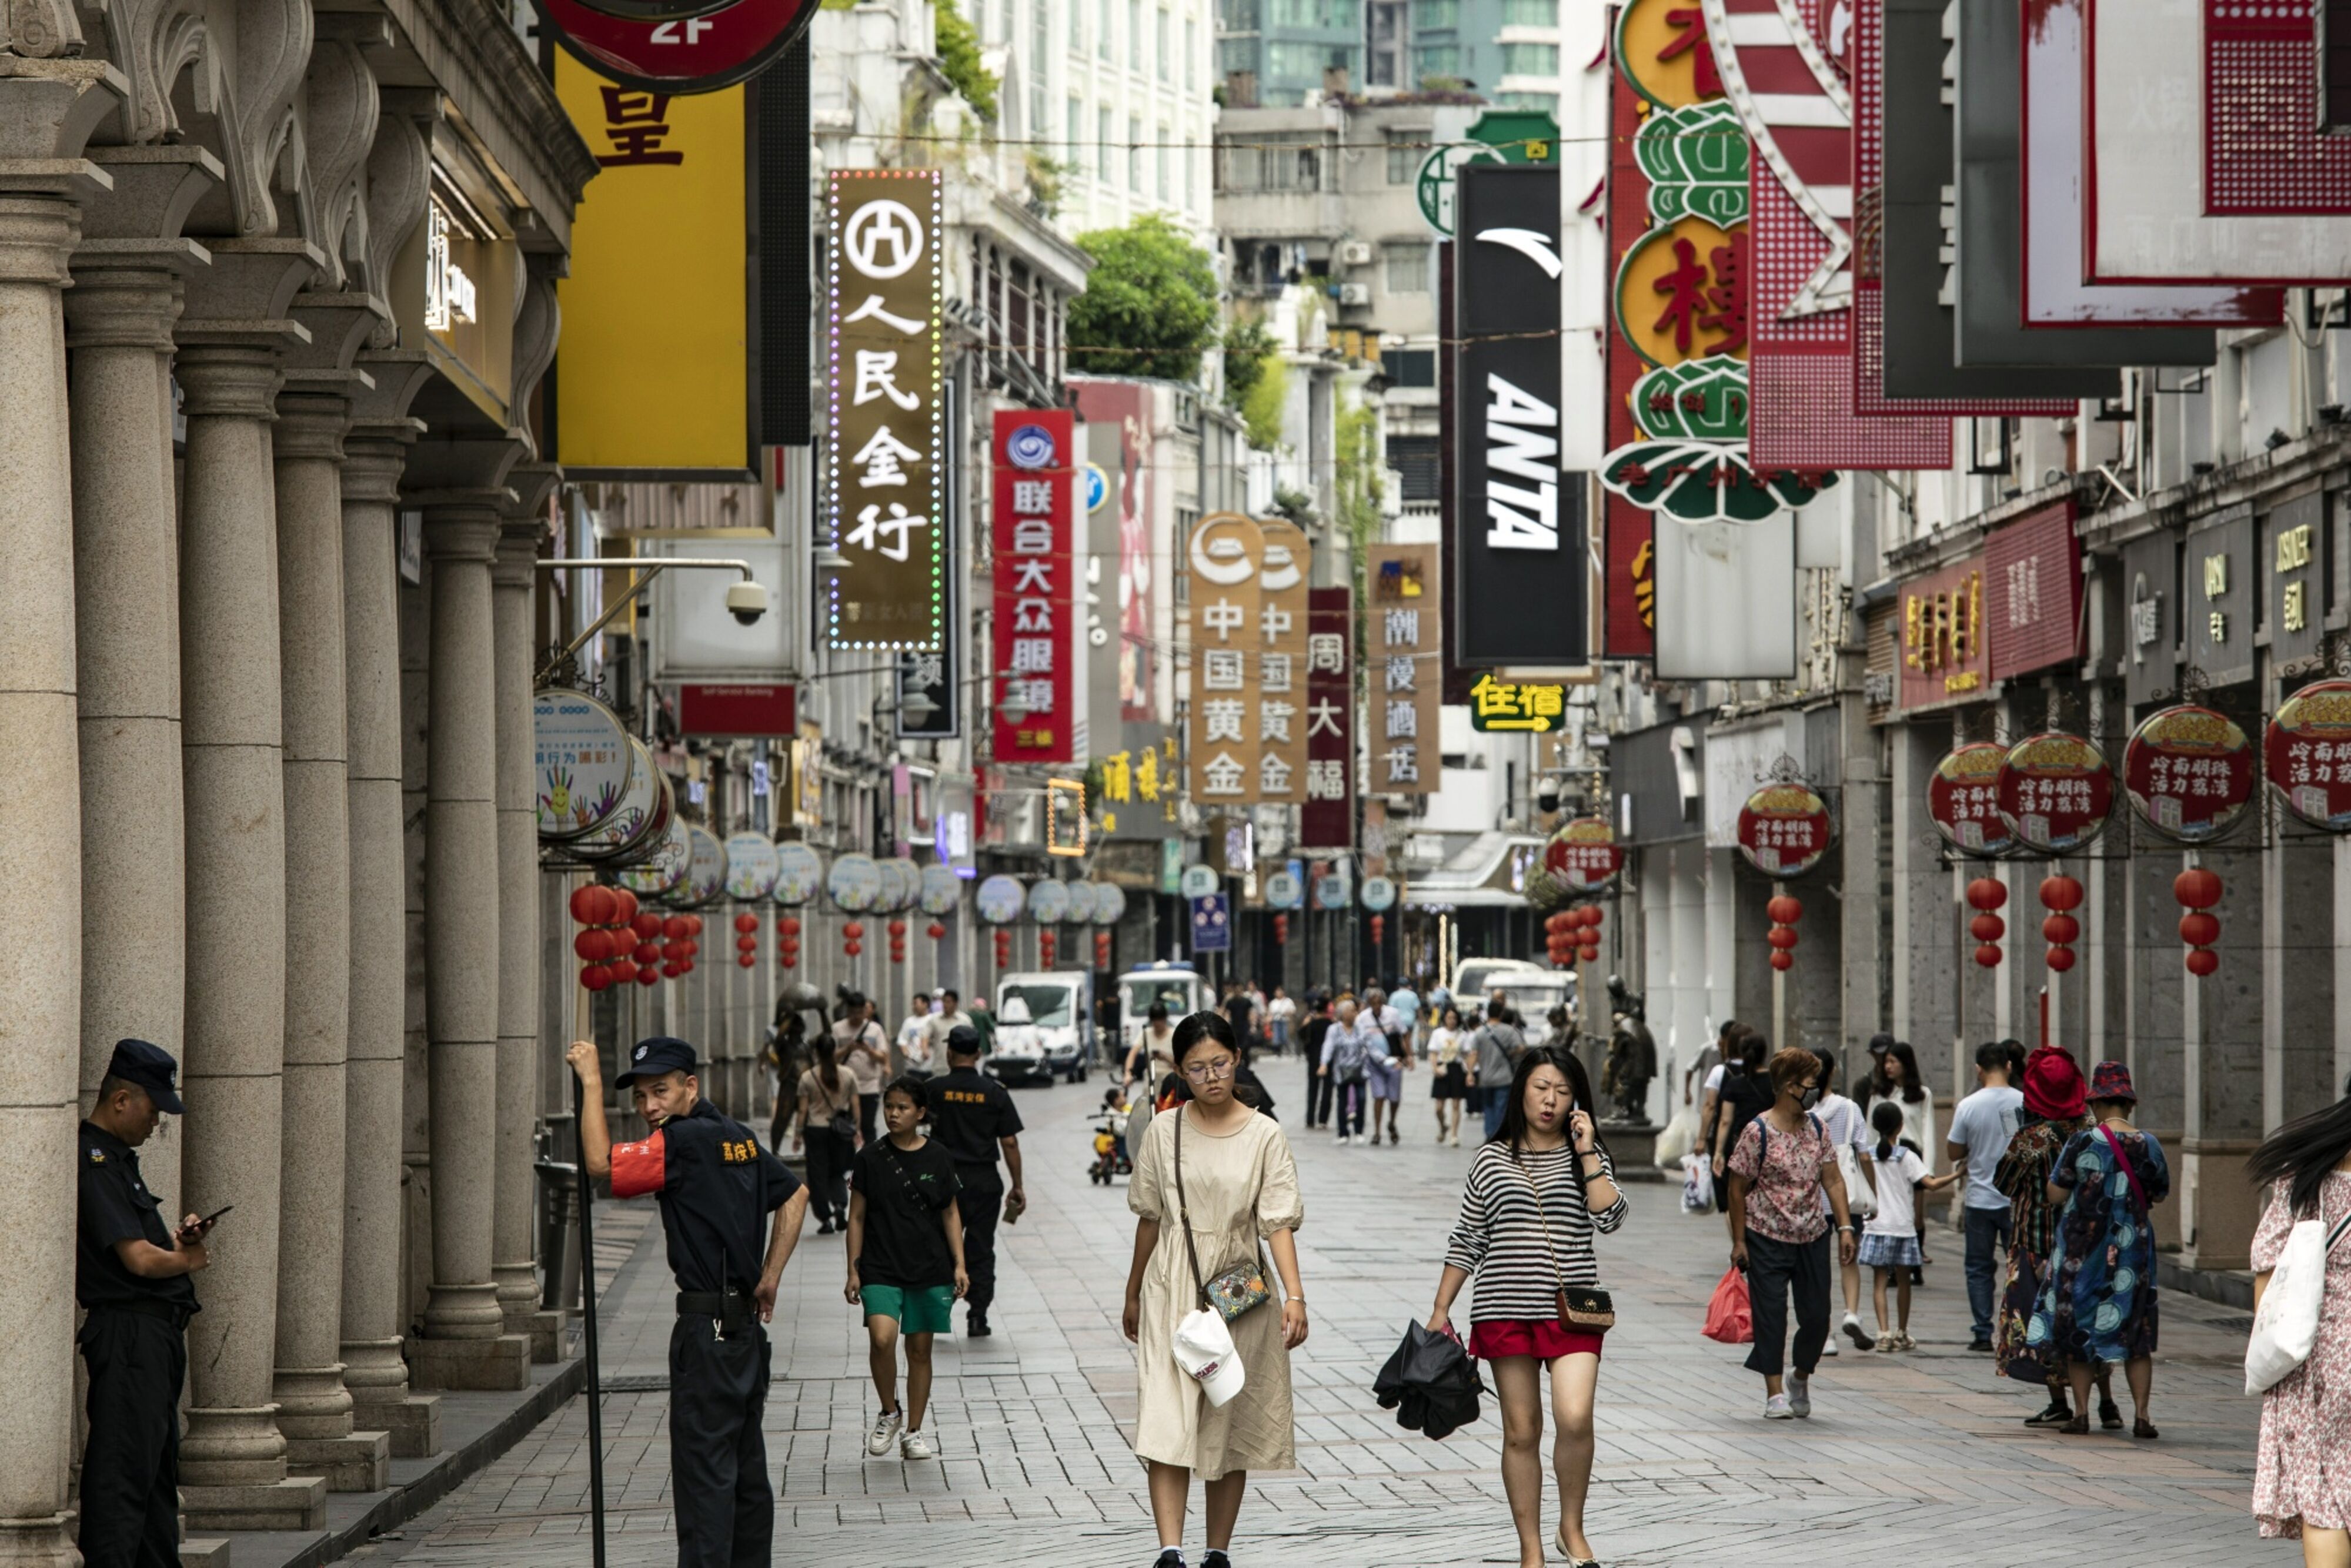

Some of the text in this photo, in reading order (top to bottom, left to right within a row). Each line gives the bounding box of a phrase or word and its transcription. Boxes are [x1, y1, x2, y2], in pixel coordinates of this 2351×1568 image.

[650, 17, 713, 44] 2F
[596, 85, 684, 167] 皇
[843, 293, 928, 563] 人民金行
[1486, 372, 1558, 550] ANTA
[1013, 480, 1053, 714] 联合大众眼镜
[1203, 597, 1245, 795] 中国黄金
[1260, 603, 1292, 794] 中国黄金
[1307, 633, 1345, 800] 周大福
[1471, 674, 1563, 716] 住宿
[2018, 778, 2092, 795] 岭南明珠
[2150, 756, 2232, 778] 岭南明珠
[2150, 775, 2229, 798] 活力荔湾
